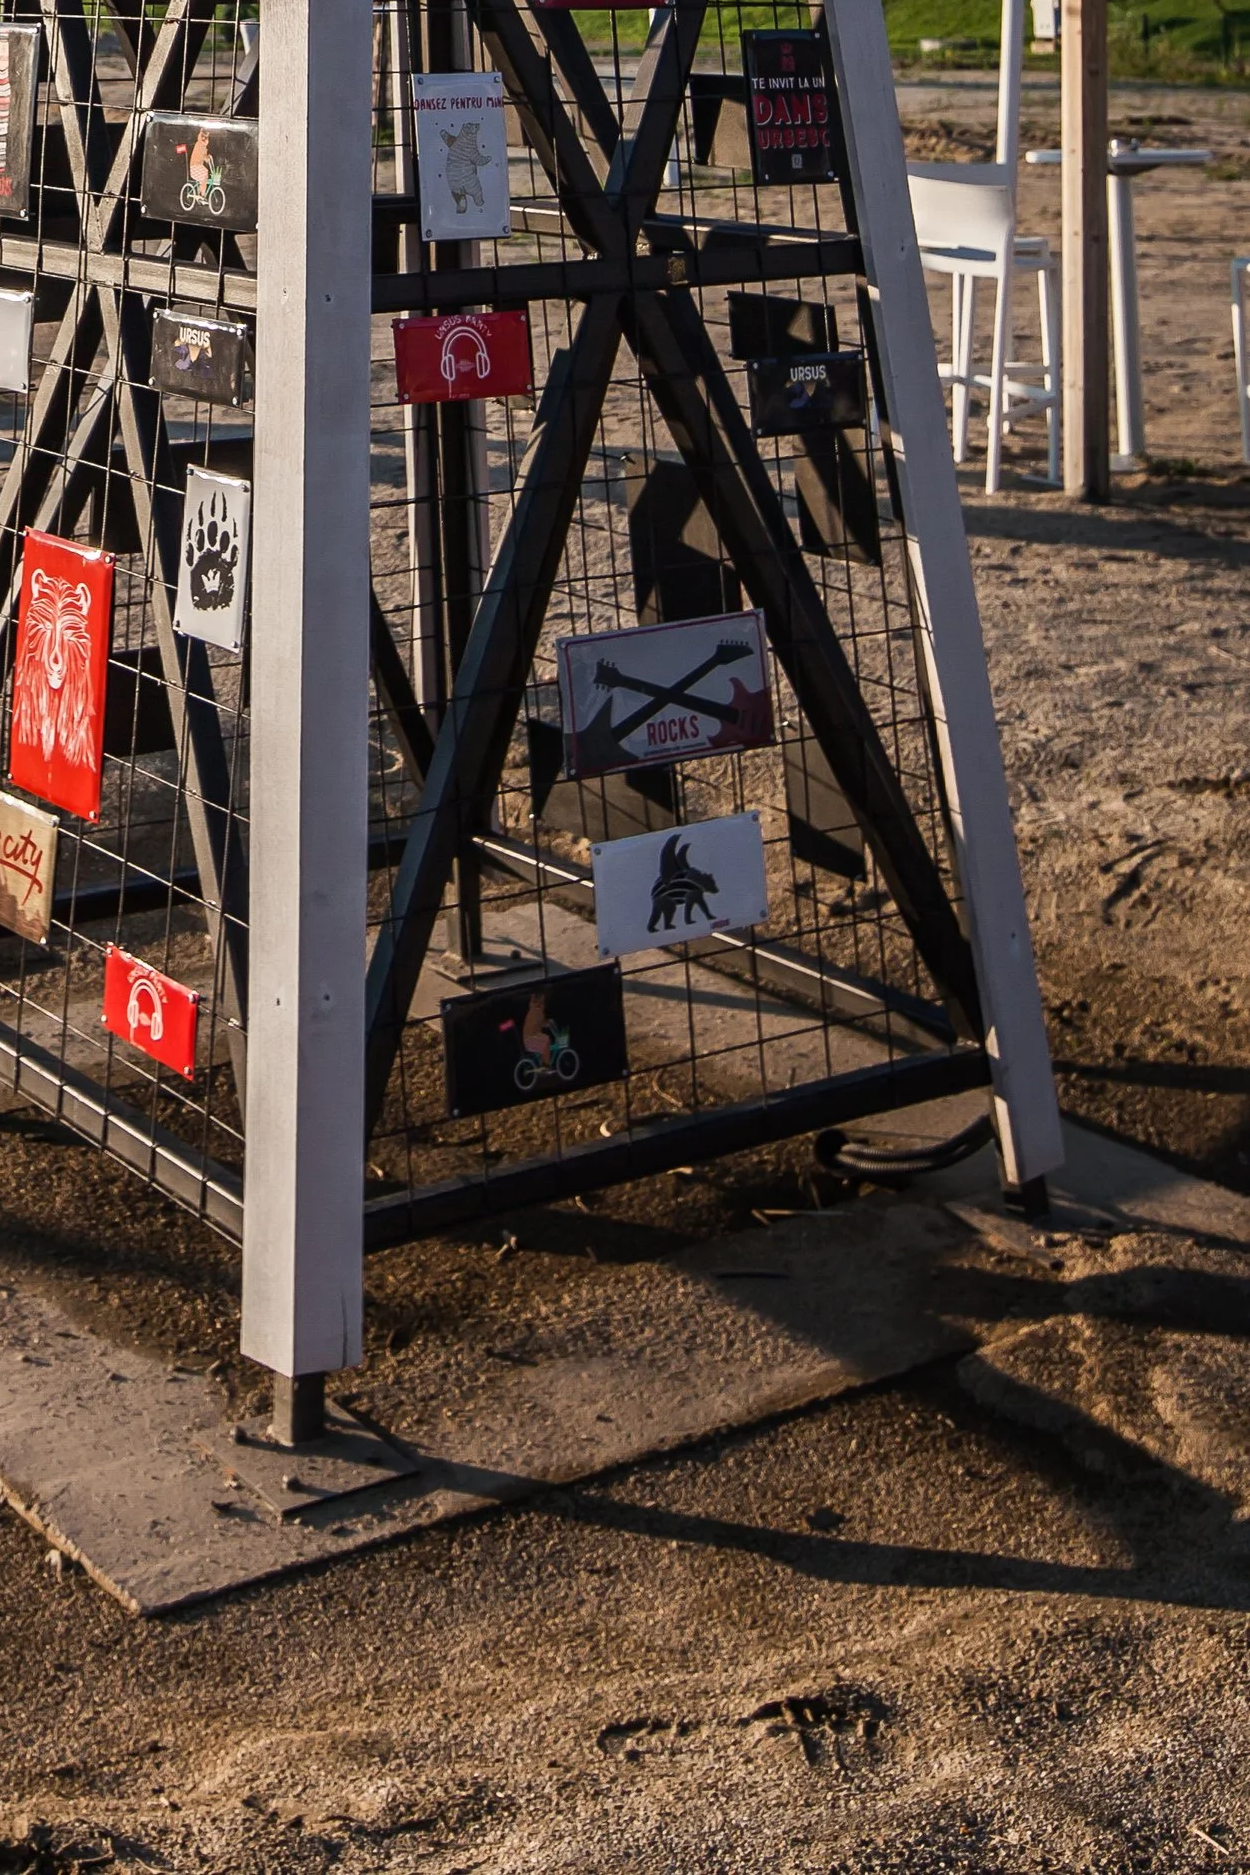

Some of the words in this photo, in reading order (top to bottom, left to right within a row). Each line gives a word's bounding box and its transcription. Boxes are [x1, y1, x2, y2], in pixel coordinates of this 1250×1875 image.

[751, 77, 766, 90] TE
[768, 77, 795, 89] INVIT
[798, 76, 810, 89] LA
[812, 76, 826, 88] UN
[413, 96, 447, 111] DANSEZ
[450, 96, 483, 110] PENTRU
[752, 92, 829, 126] DANS
[179, 326, 211, 348] URSUS
[790, 364, 827, 382] URSUS
[646, 714, 701, 746] ROCKS
